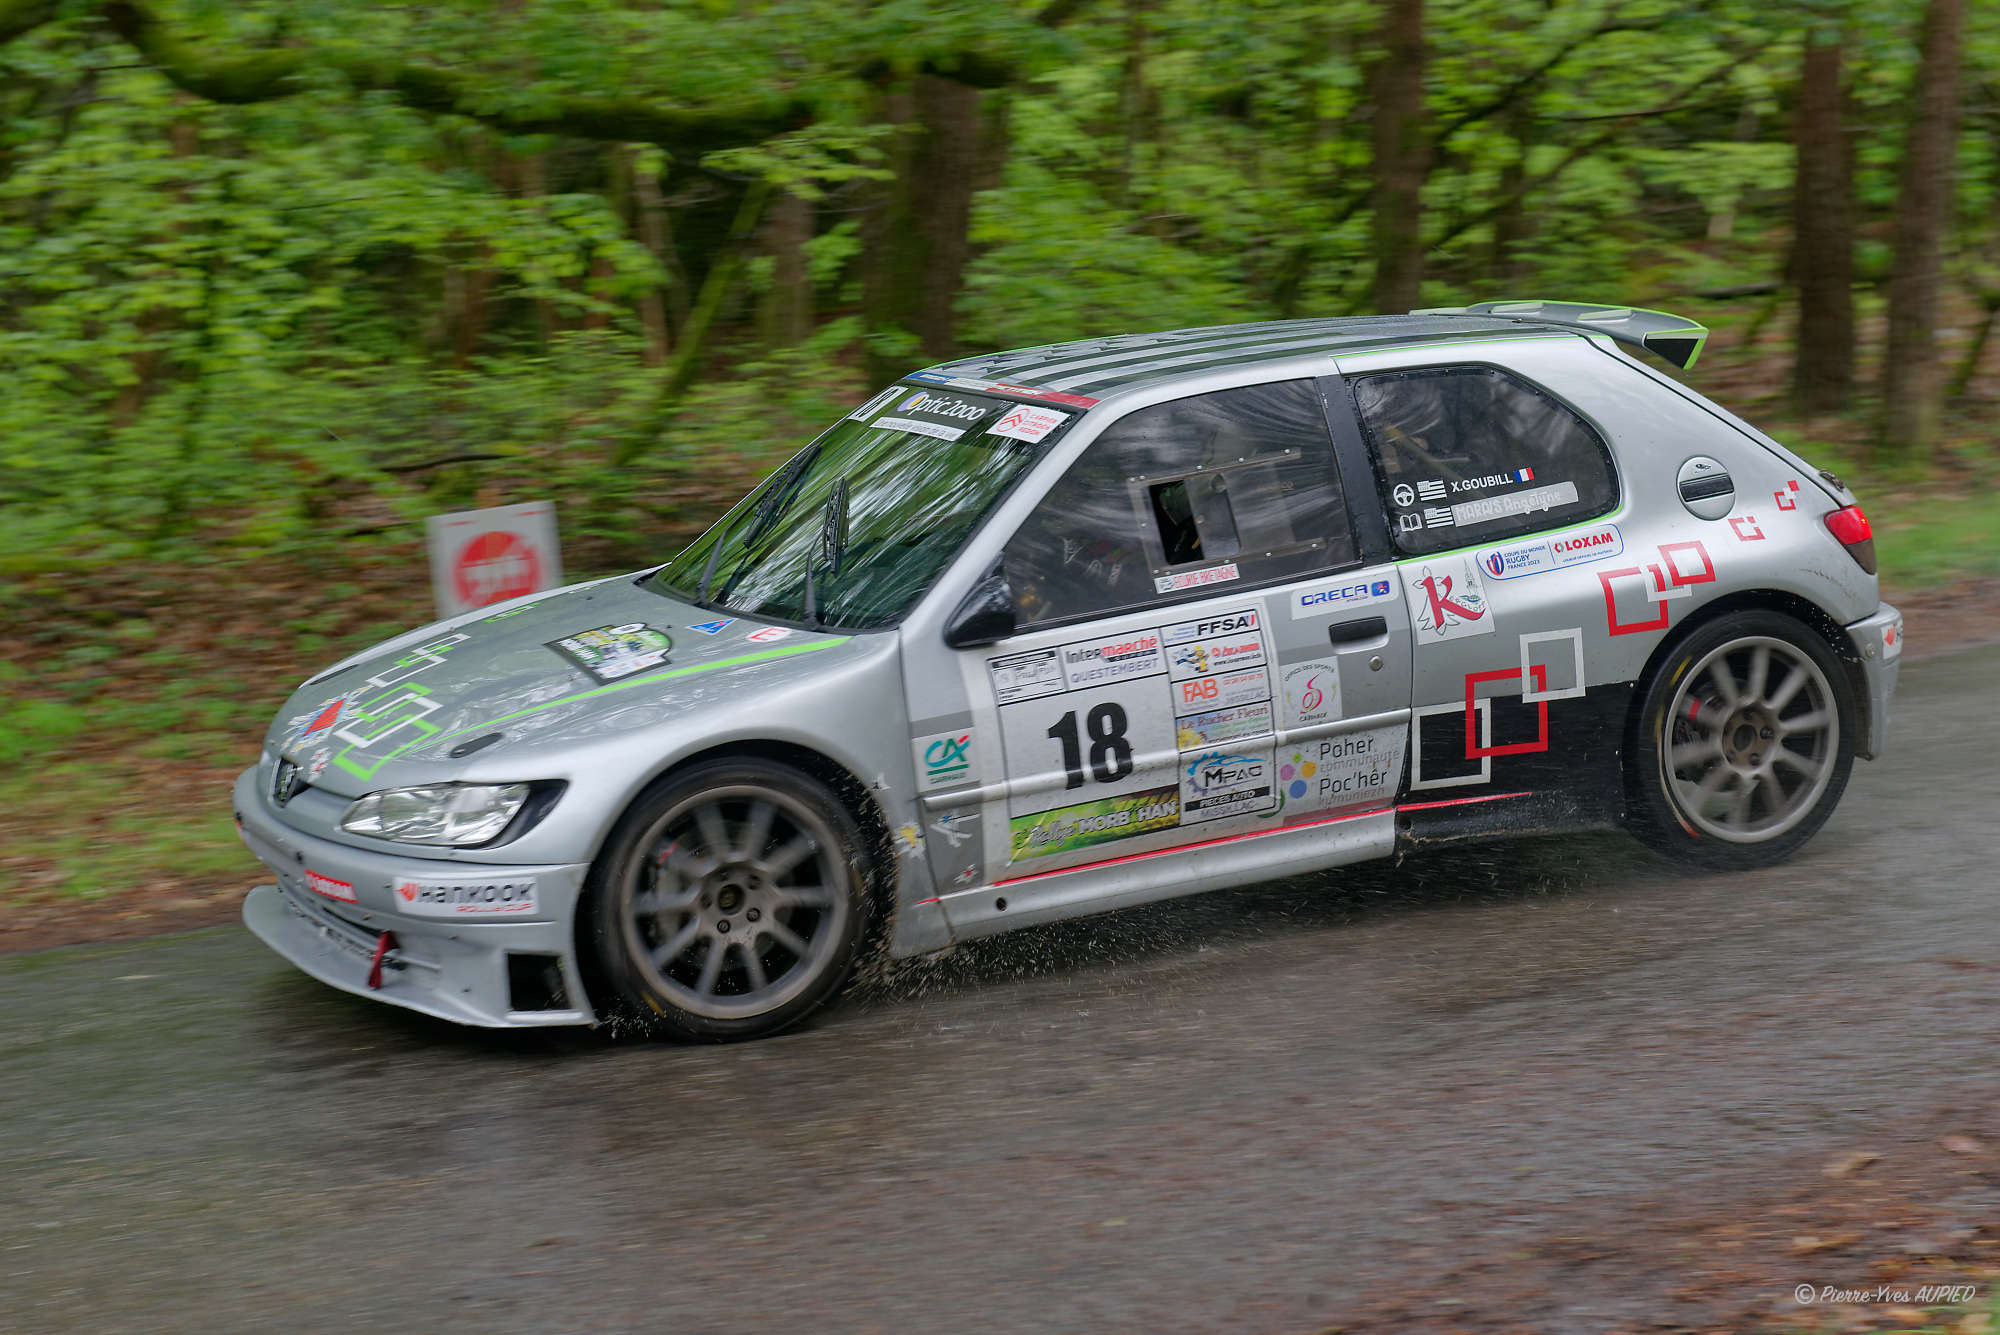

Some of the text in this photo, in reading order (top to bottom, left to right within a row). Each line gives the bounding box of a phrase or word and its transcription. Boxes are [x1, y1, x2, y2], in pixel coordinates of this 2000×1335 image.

[1450, 473, 1514, 493] X.GOUBILL
[1565, 532, 1614, 551] LOXAM
[1505, 553, 1531, 565] RUGBY
[1507, 562, 1527, 570] FRANCE
[1197, 616, 1249, 636] FFSA
[1071, 657, 1159, 683] QUESTEMBERT
[1183, 679, 1219, 703] FAB
[1048, 702, 1132, 790] 18
[1320, 738, 1374, 761] Poher
